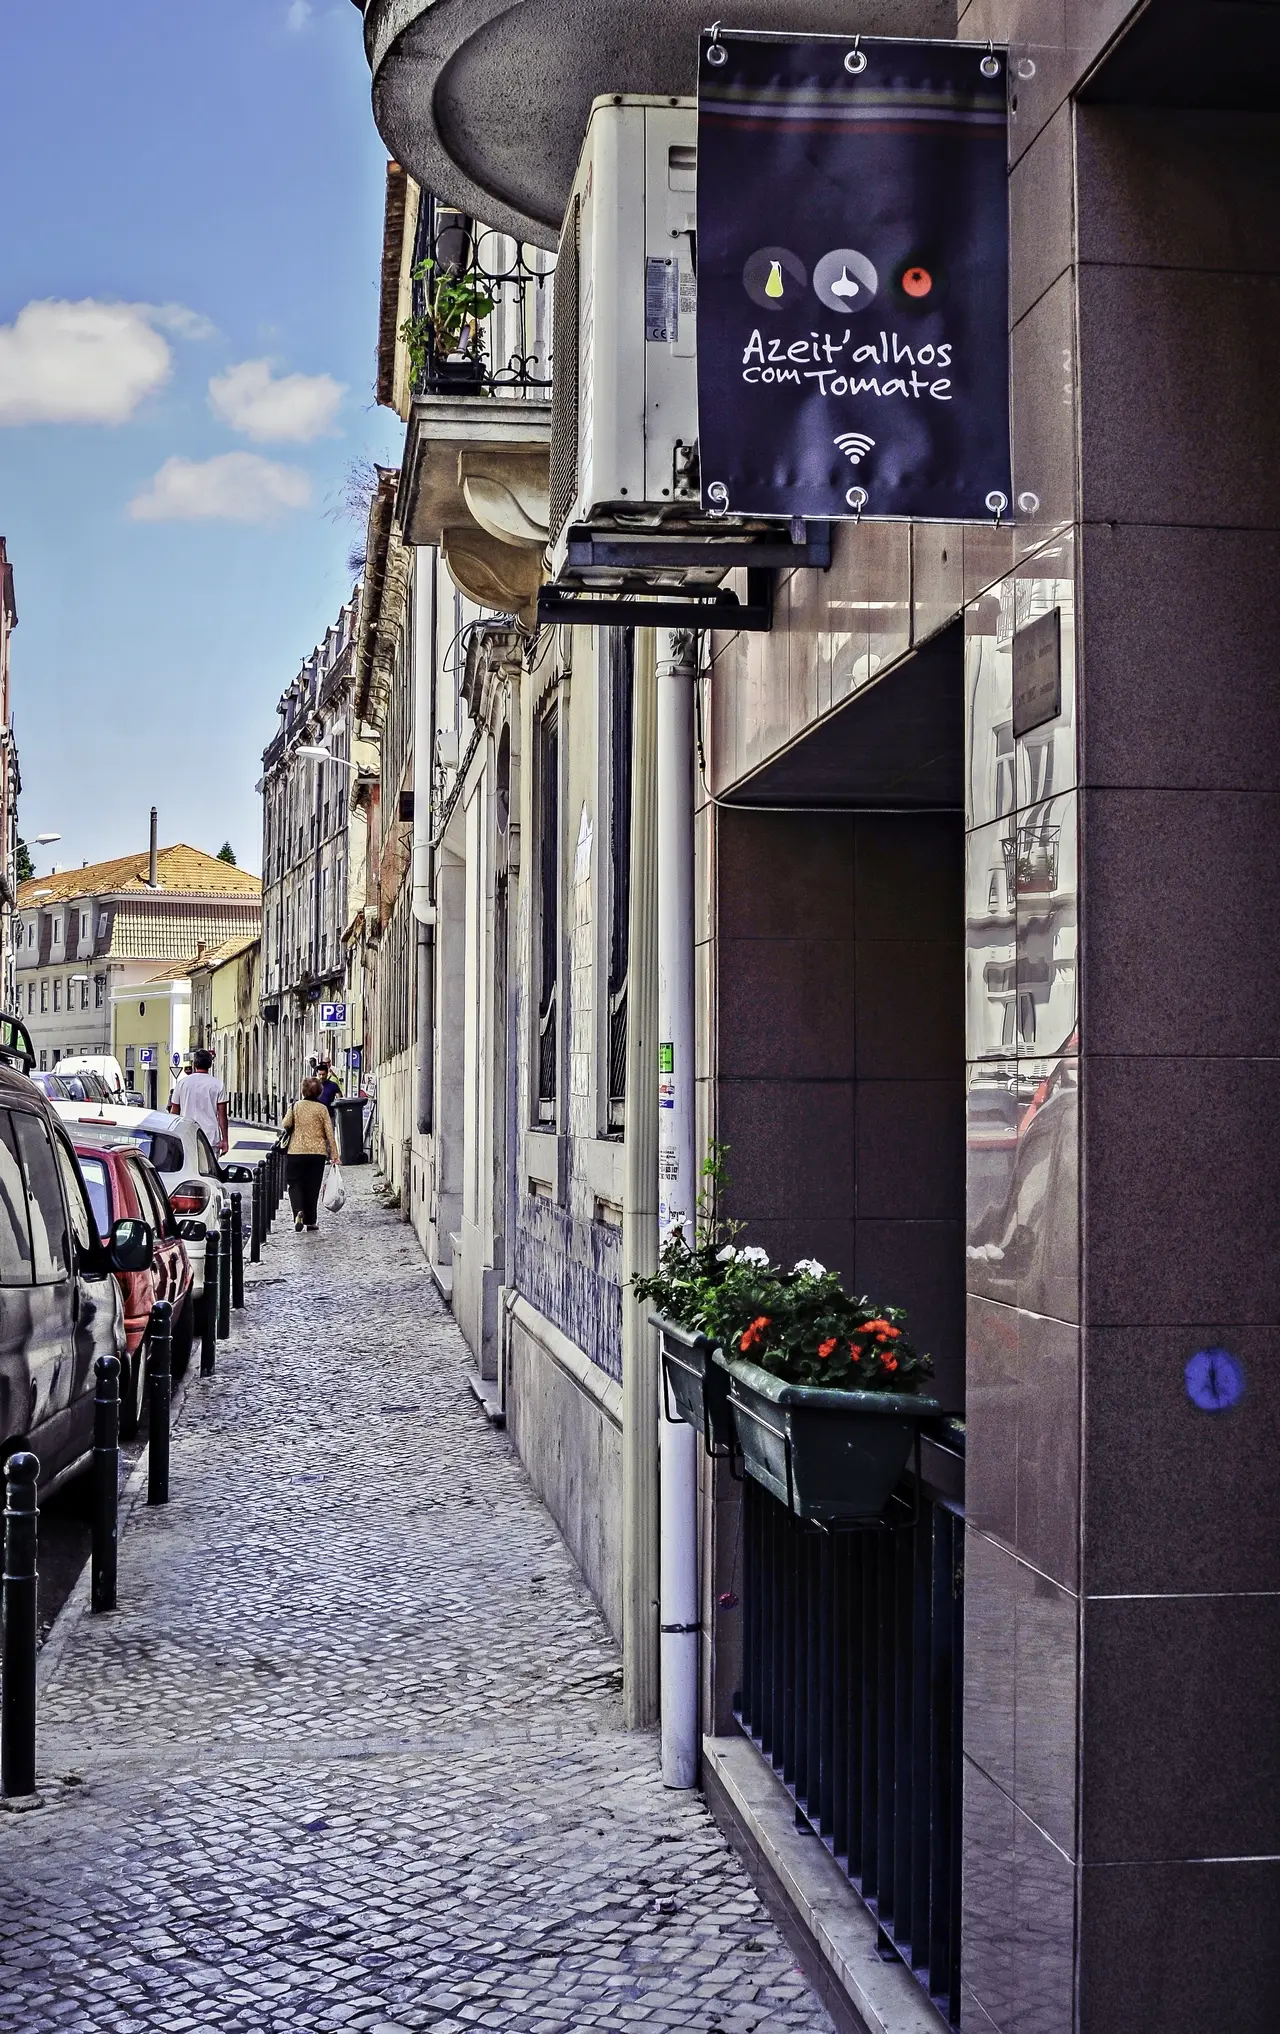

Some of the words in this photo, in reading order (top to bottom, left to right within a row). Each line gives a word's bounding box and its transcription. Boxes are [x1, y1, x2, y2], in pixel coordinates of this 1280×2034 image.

[742, 328, 953, 367] Azeit'alhos
[742, 367, 801, 385] com
[803, 369, 953, 401] Tomate
[322, 1005, 335, 1020] P
[141, 1050, 150, 1061] P
